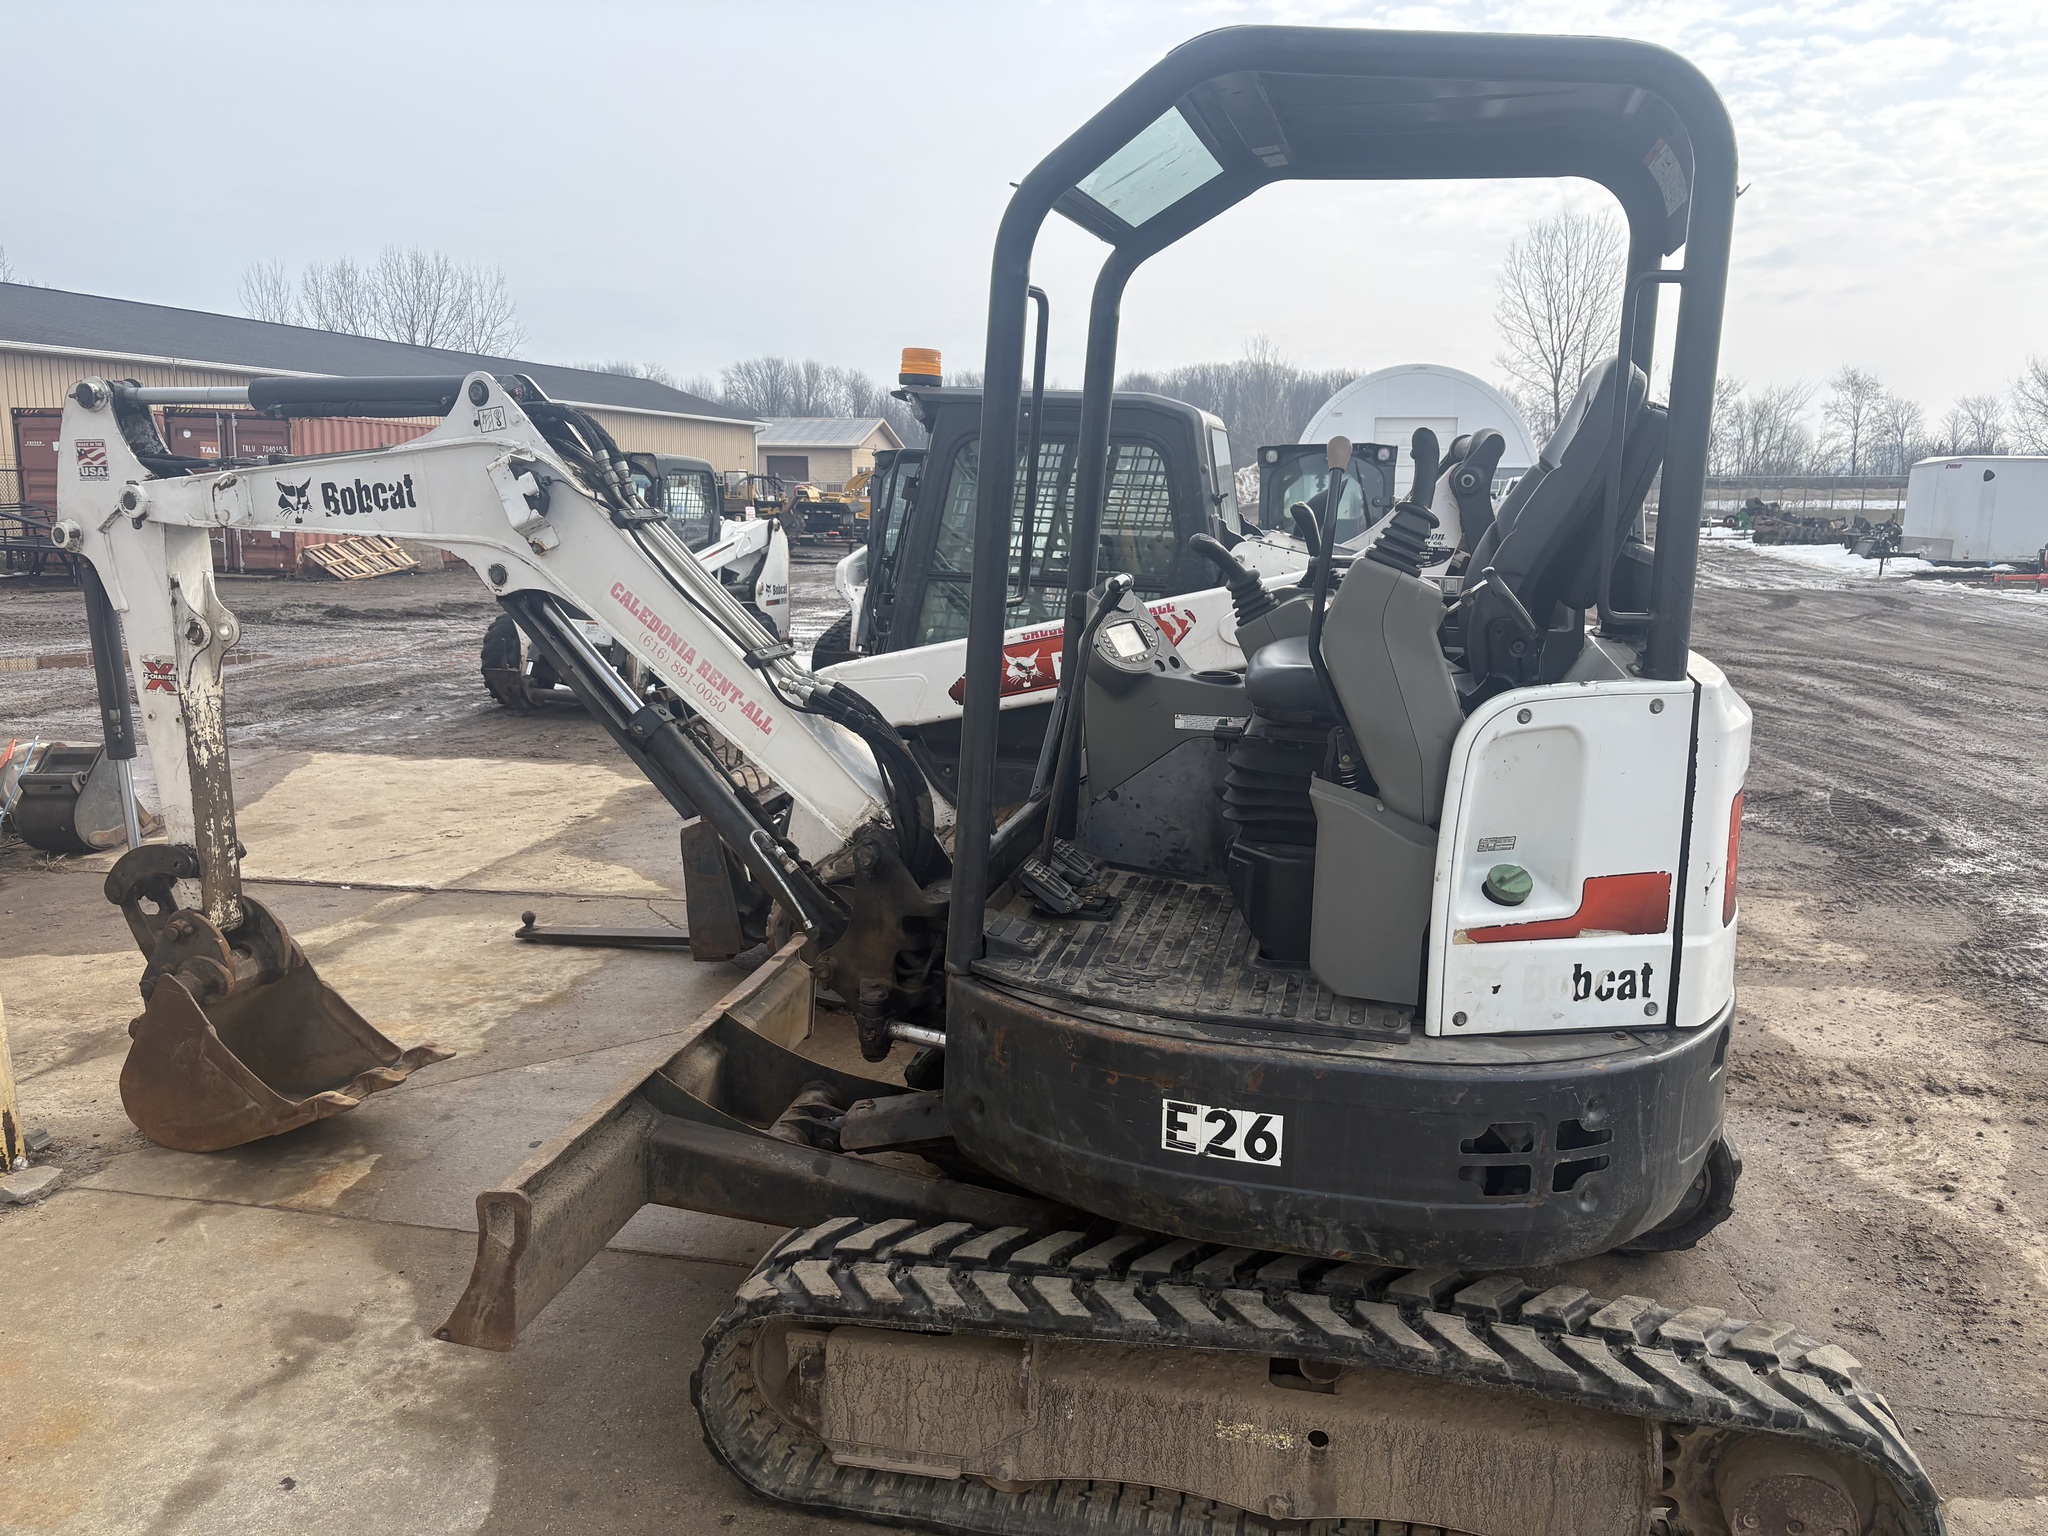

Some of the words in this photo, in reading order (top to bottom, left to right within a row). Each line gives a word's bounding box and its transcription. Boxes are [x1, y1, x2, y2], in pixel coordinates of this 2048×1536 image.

[81, 466, 107, 476] USA
[200, 446, 219, 454] TAL
[320, 473, 417, 518] Bobcat
[609, 581, 697, 666] CALEDONIA
[695, 658, 773, 736] RENT-ALL
[638, 631, 671, 665] (616)
[670, 660, 727, 713] 891-0050
[1165, 1101, 1278, 1161] E26
